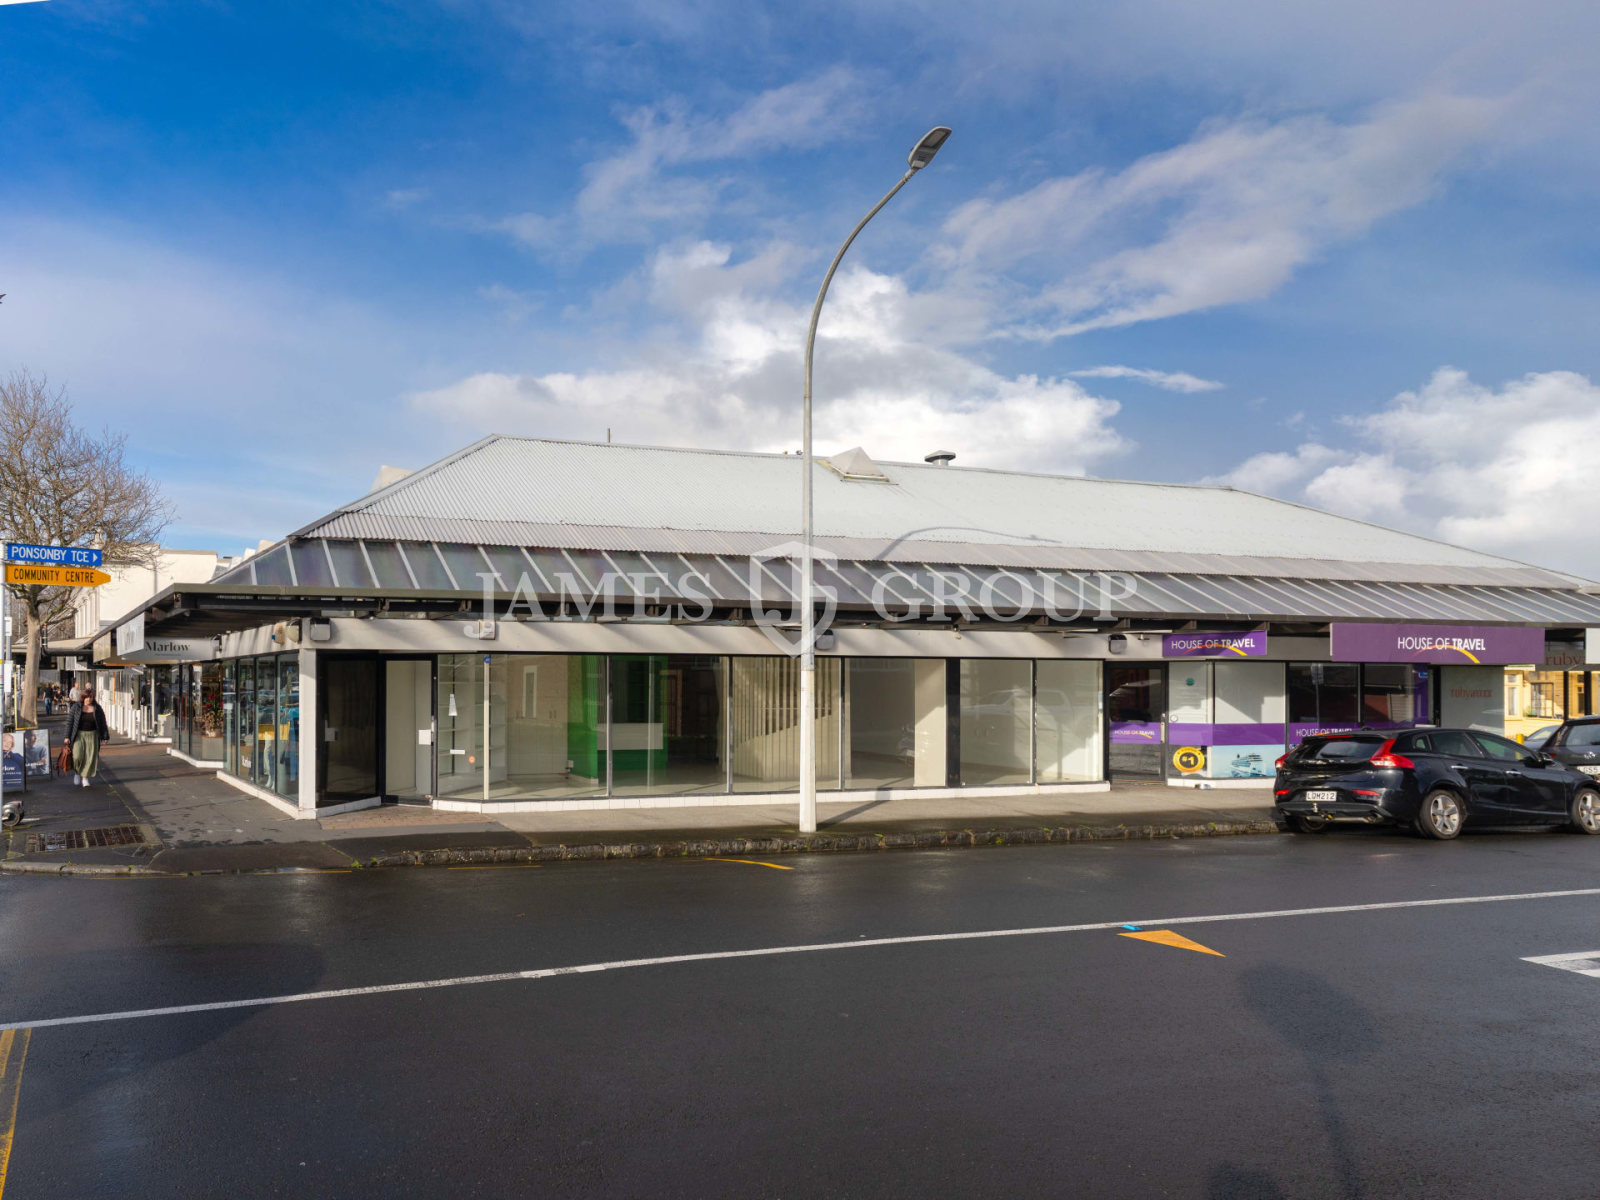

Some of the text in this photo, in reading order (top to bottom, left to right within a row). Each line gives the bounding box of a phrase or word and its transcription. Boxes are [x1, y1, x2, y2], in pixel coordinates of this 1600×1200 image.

[11, 546, 90, 562] PONSONBY TCE
[13, 568, 95, 583] COMMUNITY CENTRE
[145, 641, 190, 652] Marlow
[1171, 638, 1255, 650] HOUSE OF TRAVEL
[1397, 637, 1486, 650] HOUSE OF TRAVEL
[1295, 728, 1319, 737] HOUSE
[1320, 728, 1330, 736] OF
